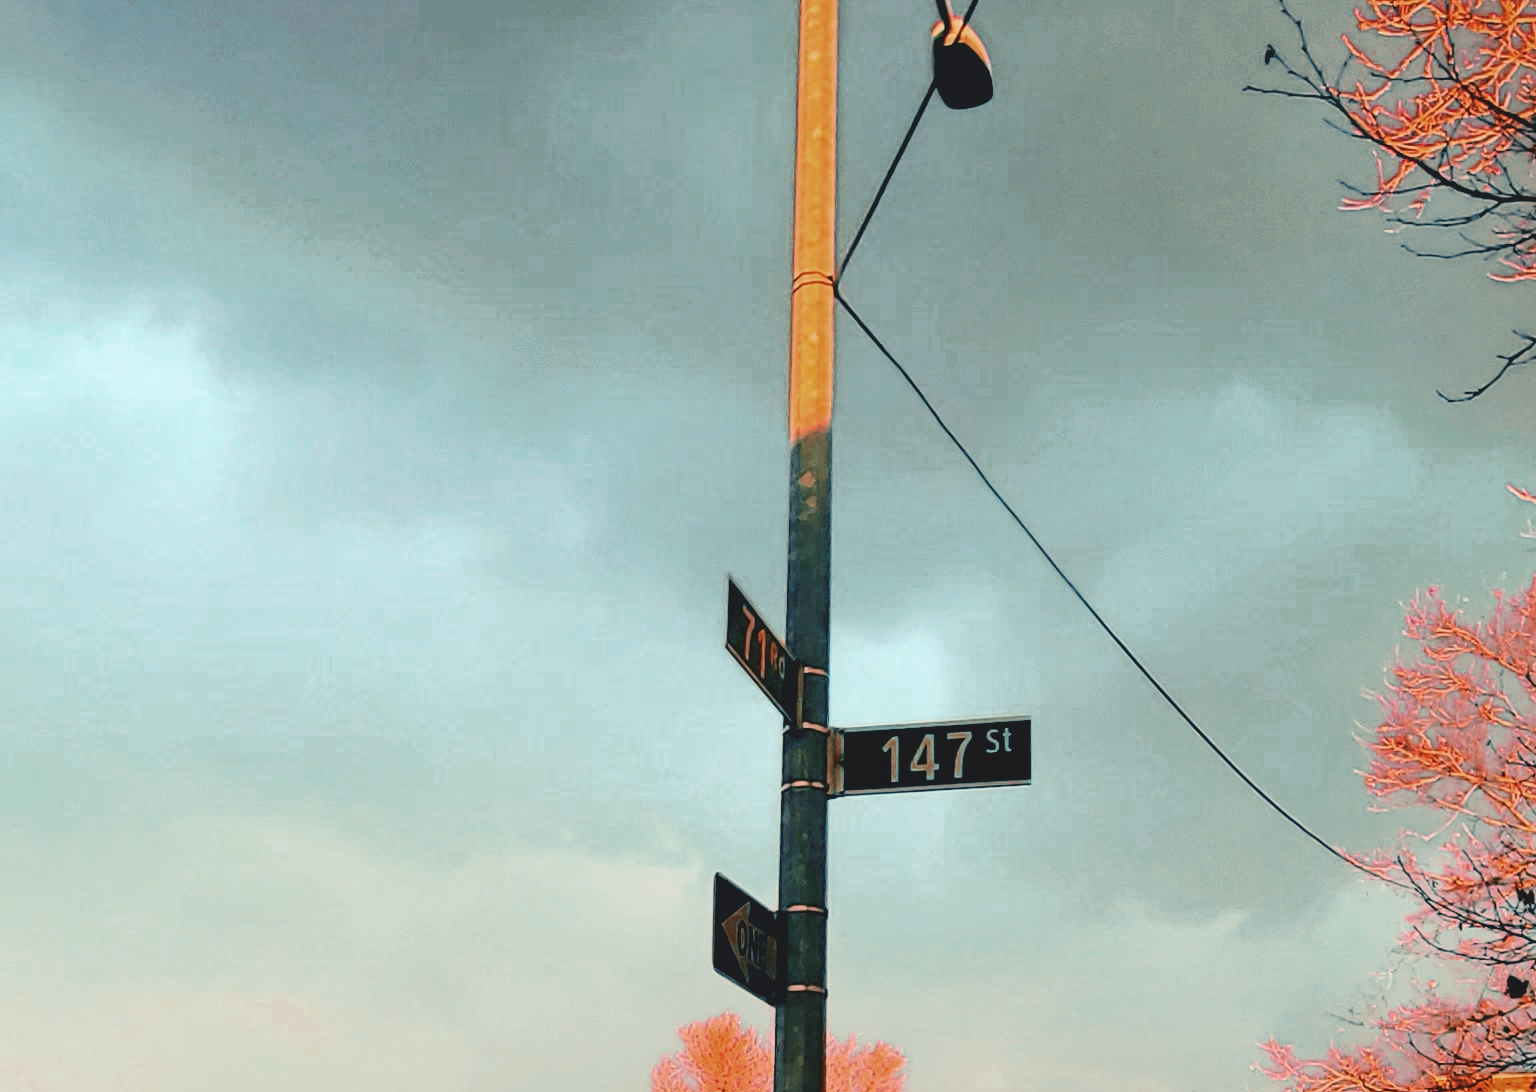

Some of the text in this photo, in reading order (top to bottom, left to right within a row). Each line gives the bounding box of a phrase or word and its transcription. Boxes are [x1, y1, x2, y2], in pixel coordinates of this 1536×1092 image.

[742, 603, 767, 680] 71
[882, 728, 1012, 783] 147 St
